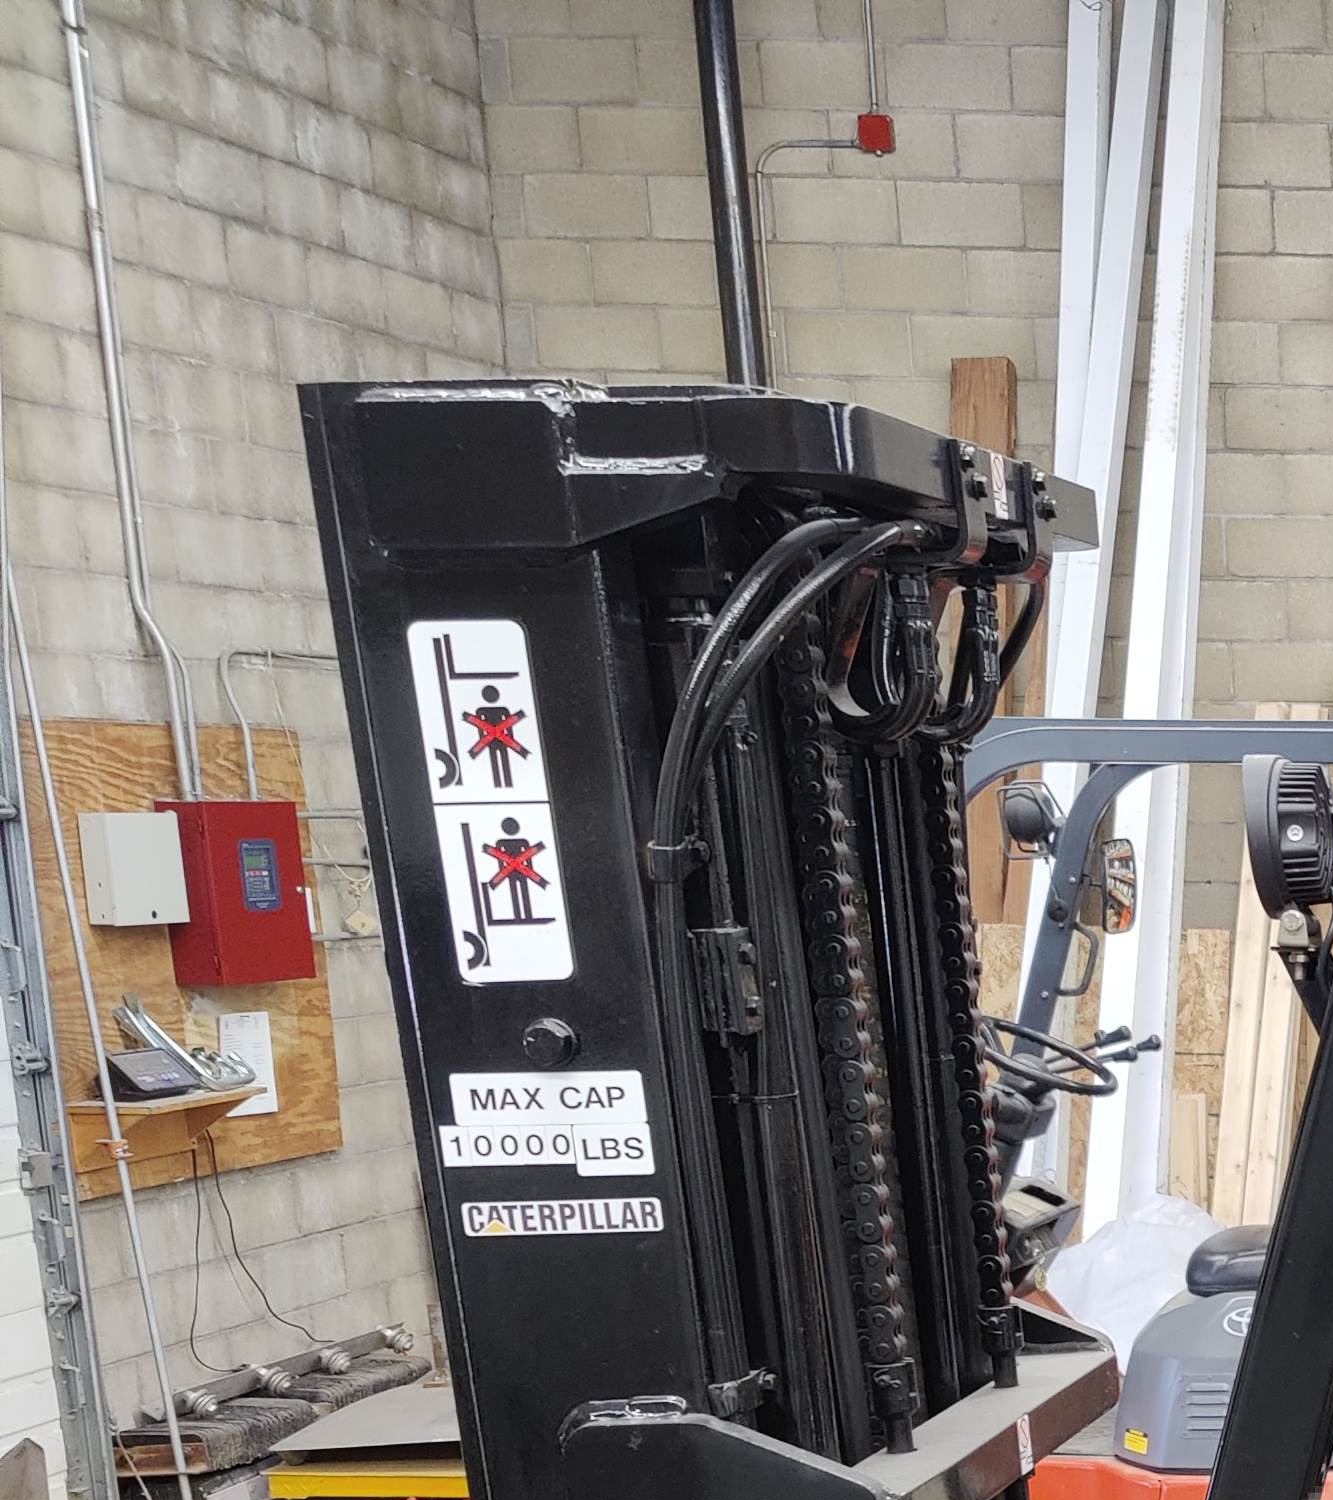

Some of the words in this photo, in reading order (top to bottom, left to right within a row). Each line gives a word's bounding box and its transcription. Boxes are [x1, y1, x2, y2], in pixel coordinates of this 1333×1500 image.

[470, 1088, 544, 1111] MAX
[560, 1087, 625, 1109] CAP
[449, 1134, 570, 1157] 10000
[582, 1137, 645, 1160] LBS
[467, 1201, 659, 1234] CATERPILLAR
